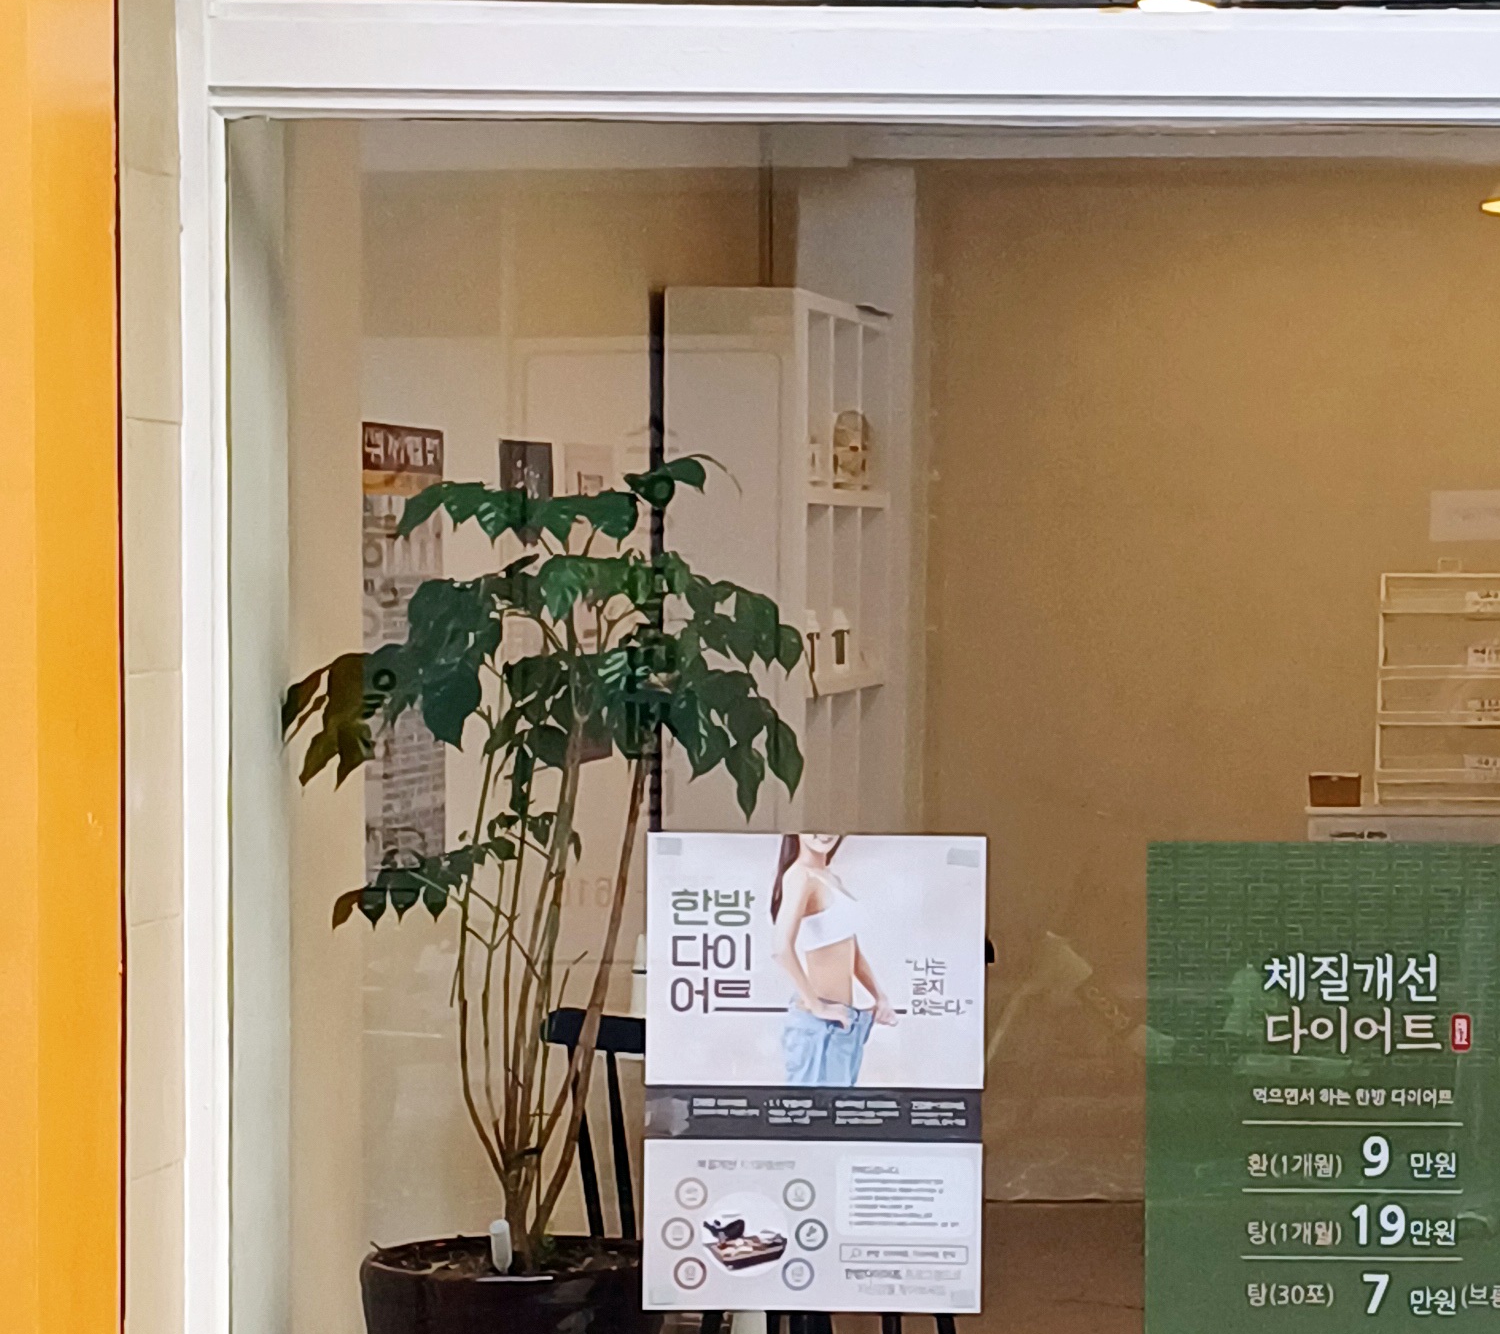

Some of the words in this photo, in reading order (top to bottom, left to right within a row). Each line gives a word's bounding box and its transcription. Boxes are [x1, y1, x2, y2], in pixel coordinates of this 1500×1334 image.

[670, 888, 756, 927] 한방
[671, 933, 752, 971] 다이
[670, 976, 789, 1014] 어트
[1263, 952, 1438, 1002] 체질개선
[1265, 1006, 1442, 1055] 다이어트
[1319, 1087, 1351, 1106] 하는
[1391, 1087, 1455, 1109] 다이어트
[1246, 1153, 1343, 1178] 환(1개월)
[1361, 1135, 1391, 1177] 9
[1409, 1152, 1457, 1179] 만원
[1246, 1220, 1343, 1246] 탕(1개월)
[1361, 1273, 1391, 1315] 7
